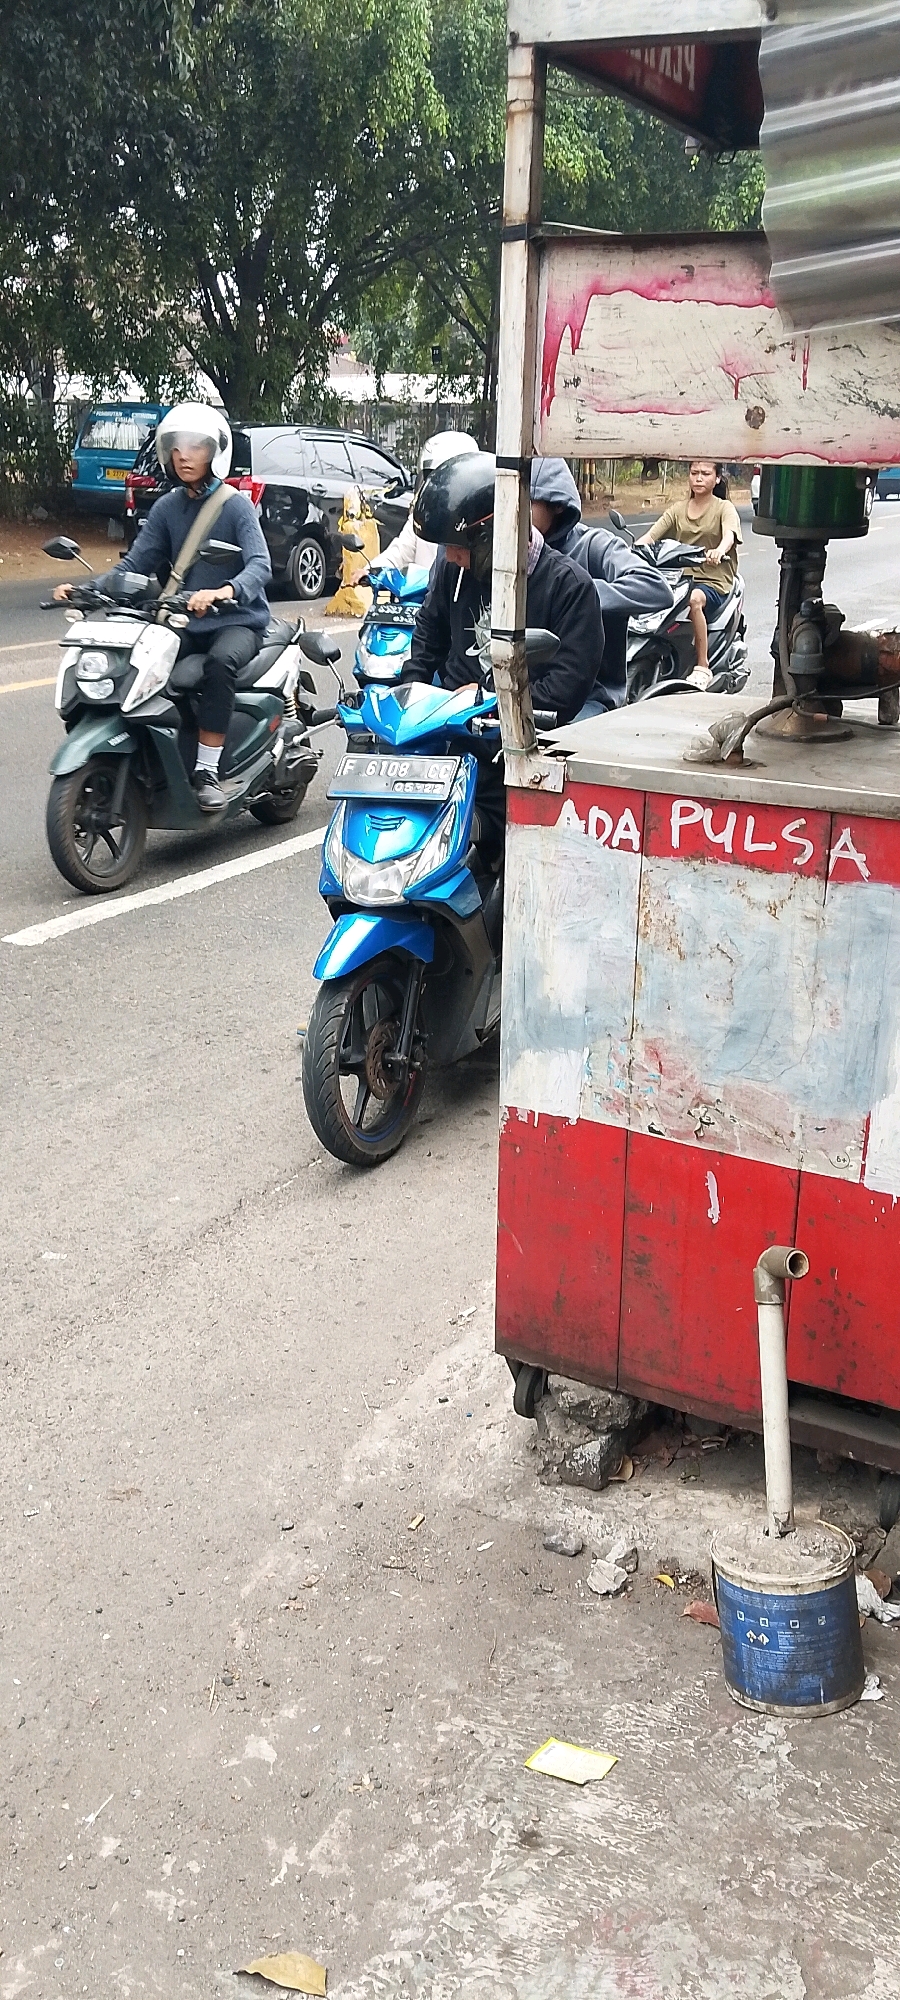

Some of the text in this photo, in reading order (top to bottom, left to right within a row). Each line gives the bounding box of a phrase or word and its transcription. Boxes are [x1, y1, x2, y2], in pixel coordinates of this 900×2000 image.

[342, 759, 357, 776] F
[366, 760, 410, 777] 6108
[553, 797, 872, 883] ADA PULSA
